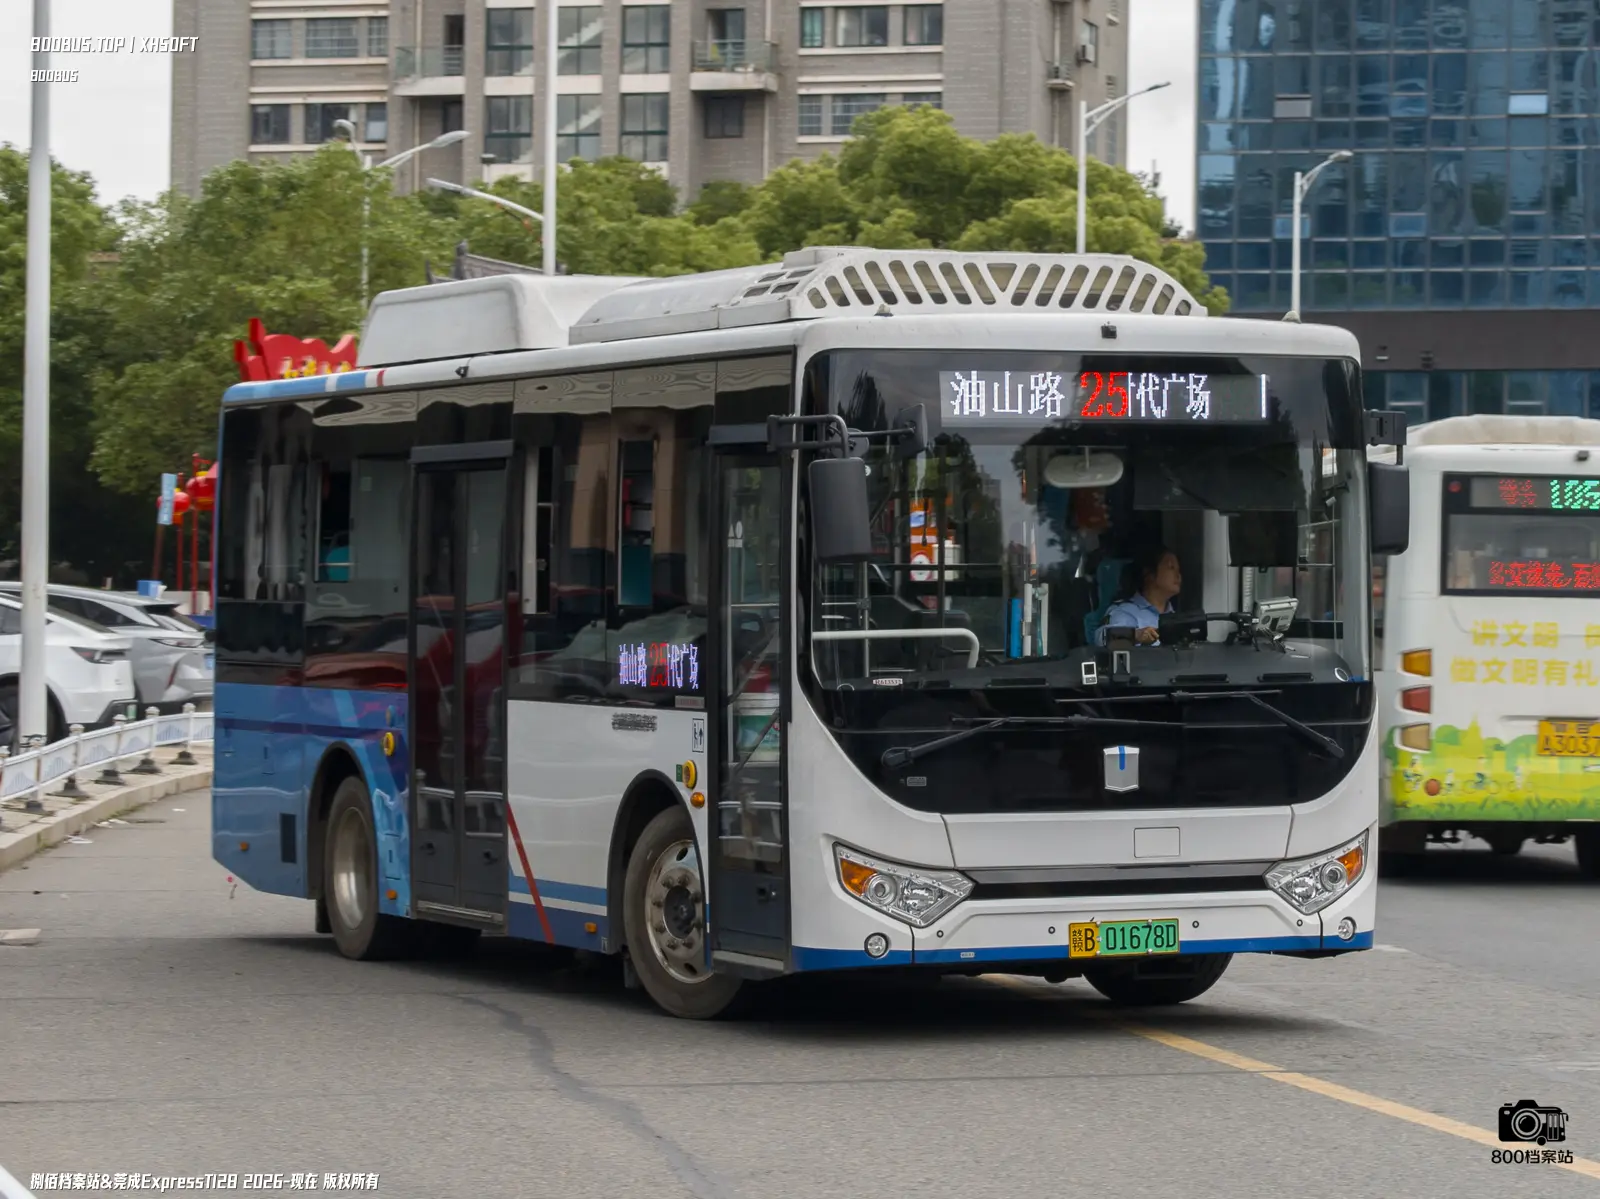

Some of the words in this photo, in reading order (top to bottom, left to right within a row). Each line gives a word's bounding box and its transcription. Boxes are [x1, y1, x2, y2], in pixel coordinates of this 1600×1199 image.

[950, 371, 1065, 416] 油山路
[1080, 371, 1128, 417] 25
[1471, 619, 1559, 648] 讲文明
[1105, 924, 1177, 950] 01678D
